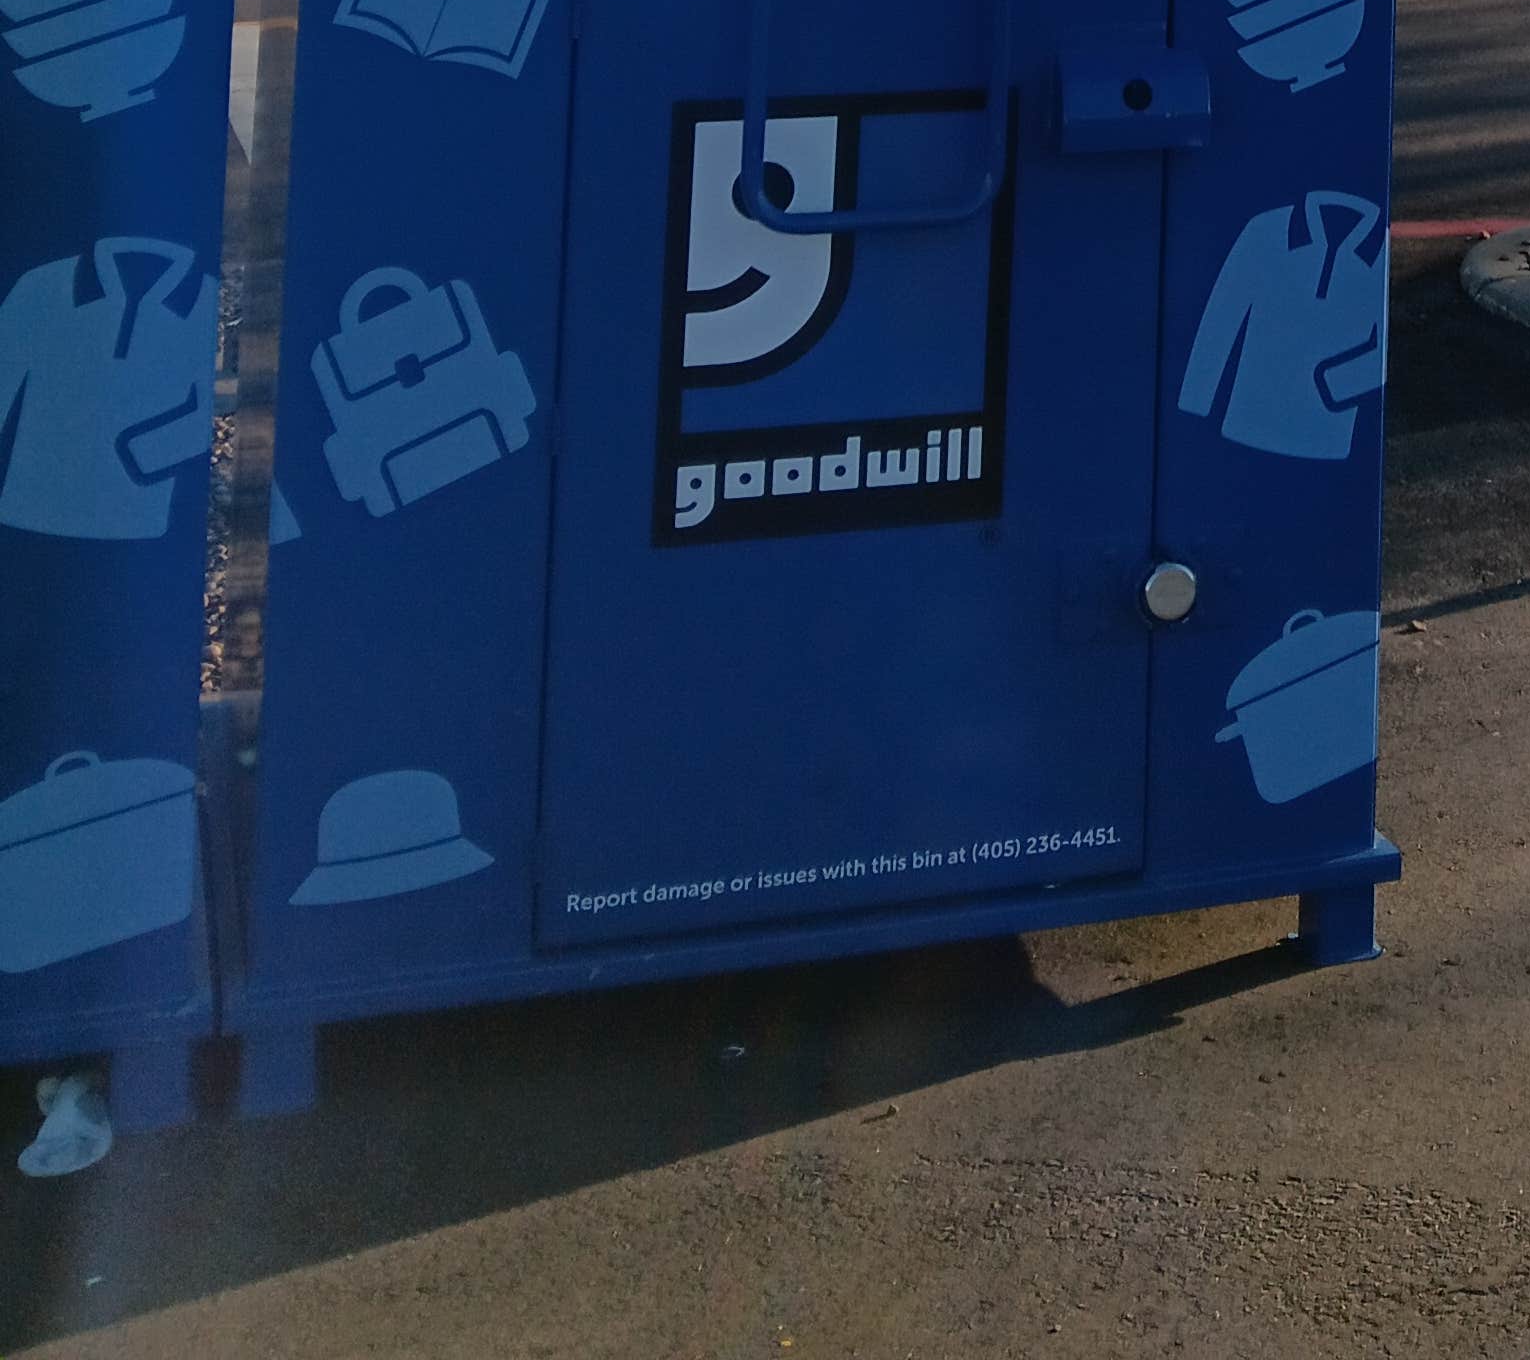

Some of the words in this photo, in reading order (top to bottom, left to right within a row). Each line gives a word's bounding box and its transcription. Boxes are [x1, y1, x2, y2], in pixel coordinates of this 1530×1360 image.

[674, 426, 983, 529] goodwill
[566, 887, 638, 914] Report
[643, 880, 725, 903] damage
[730, 876, 753, 893] or
[758, 866, 817, 889] issues
[822, 859, 866, 880] with
[871, 855, 907, 875] this
[912, 849, 942, 869] bin
[947, 847, 966, 865] at
[971, 838, 1021, 864] (405)
[1025, 826, 1121, 855] 236-4451.
